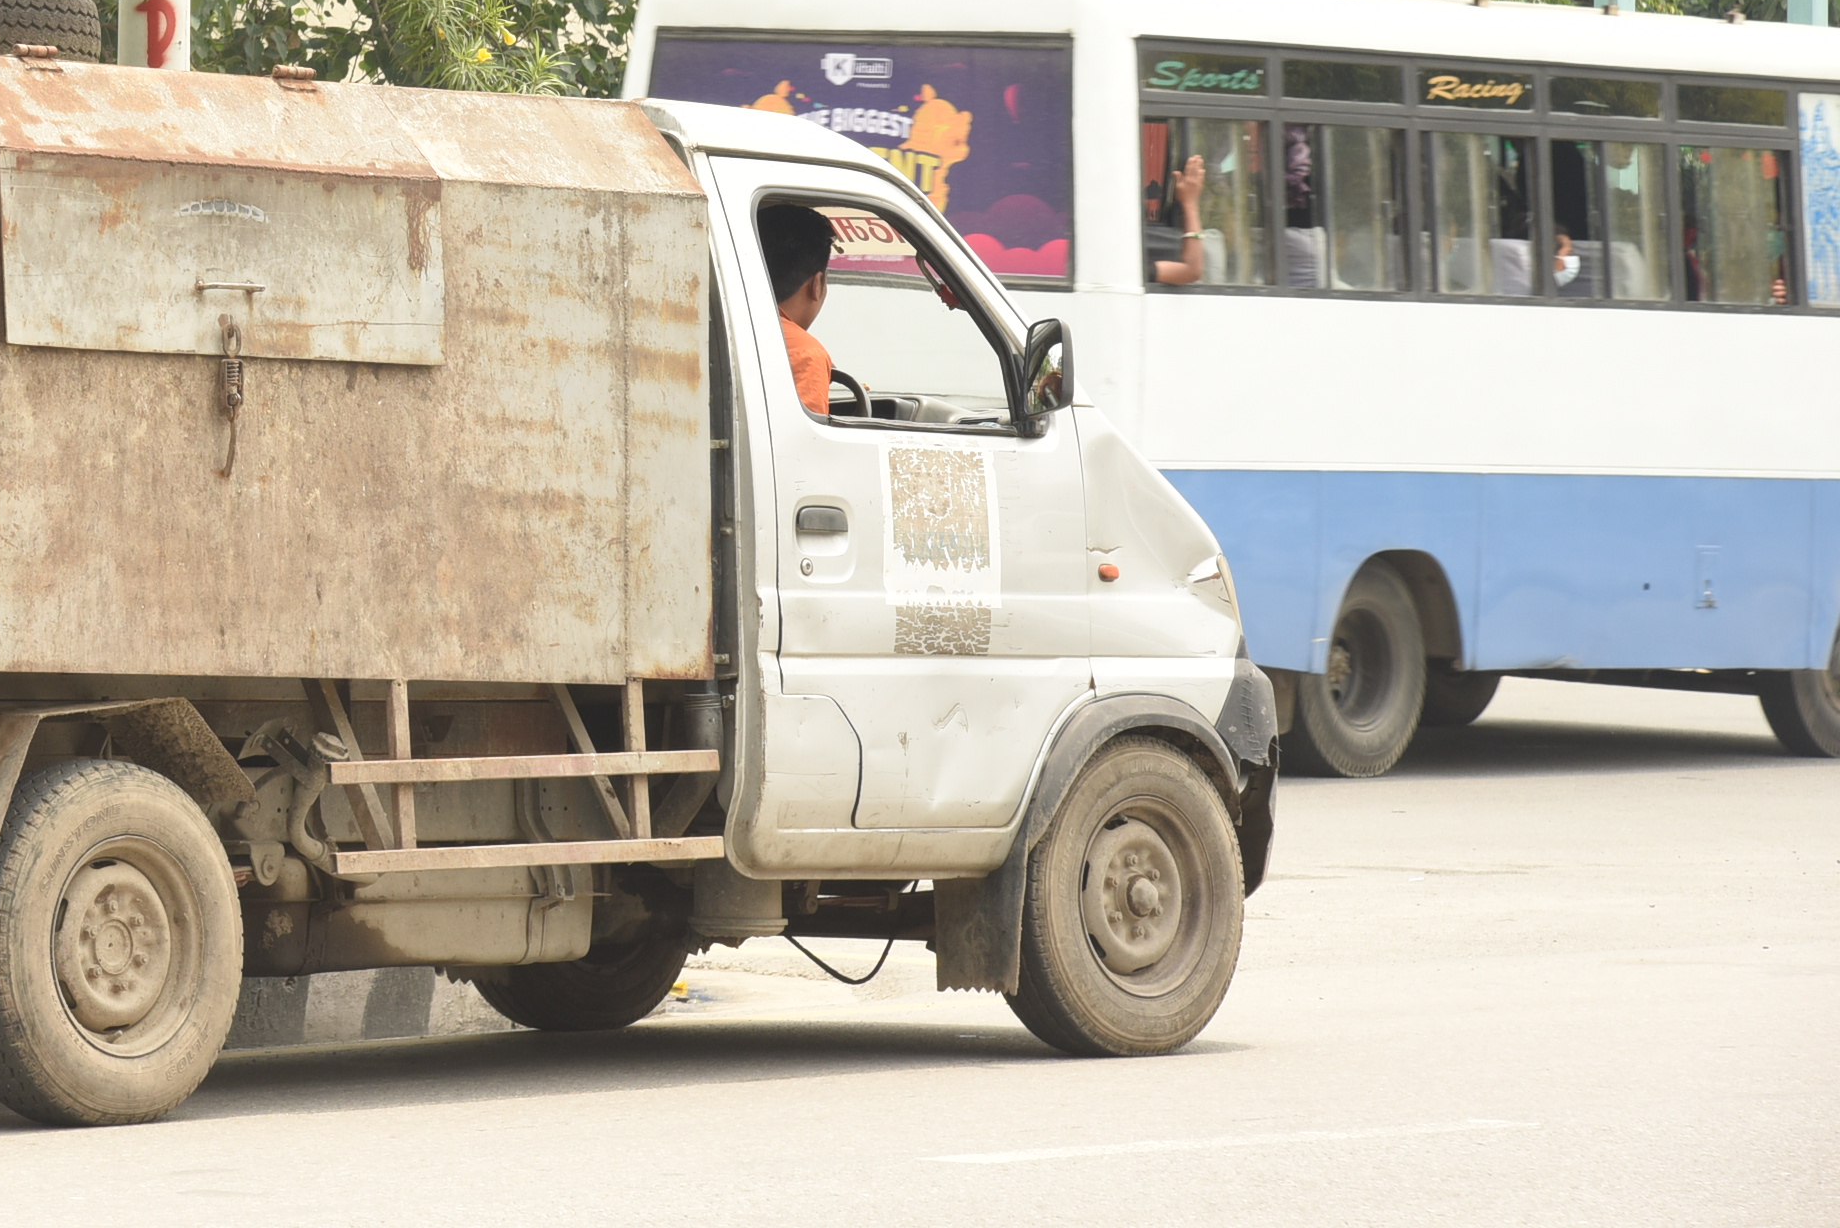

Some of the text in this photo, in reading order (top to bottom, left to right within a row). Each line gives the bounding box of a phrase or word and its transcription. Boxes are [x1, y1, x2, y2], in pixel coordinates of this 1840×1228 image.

[1148, 60, 1261, 92] Sports
[1426, 75, 1525, 105] Racing
[831, 107, 914, 139] BIGGEST
[869, 146, 942, 194] NT
[38, 802, 123, 898] SUNSTONE
